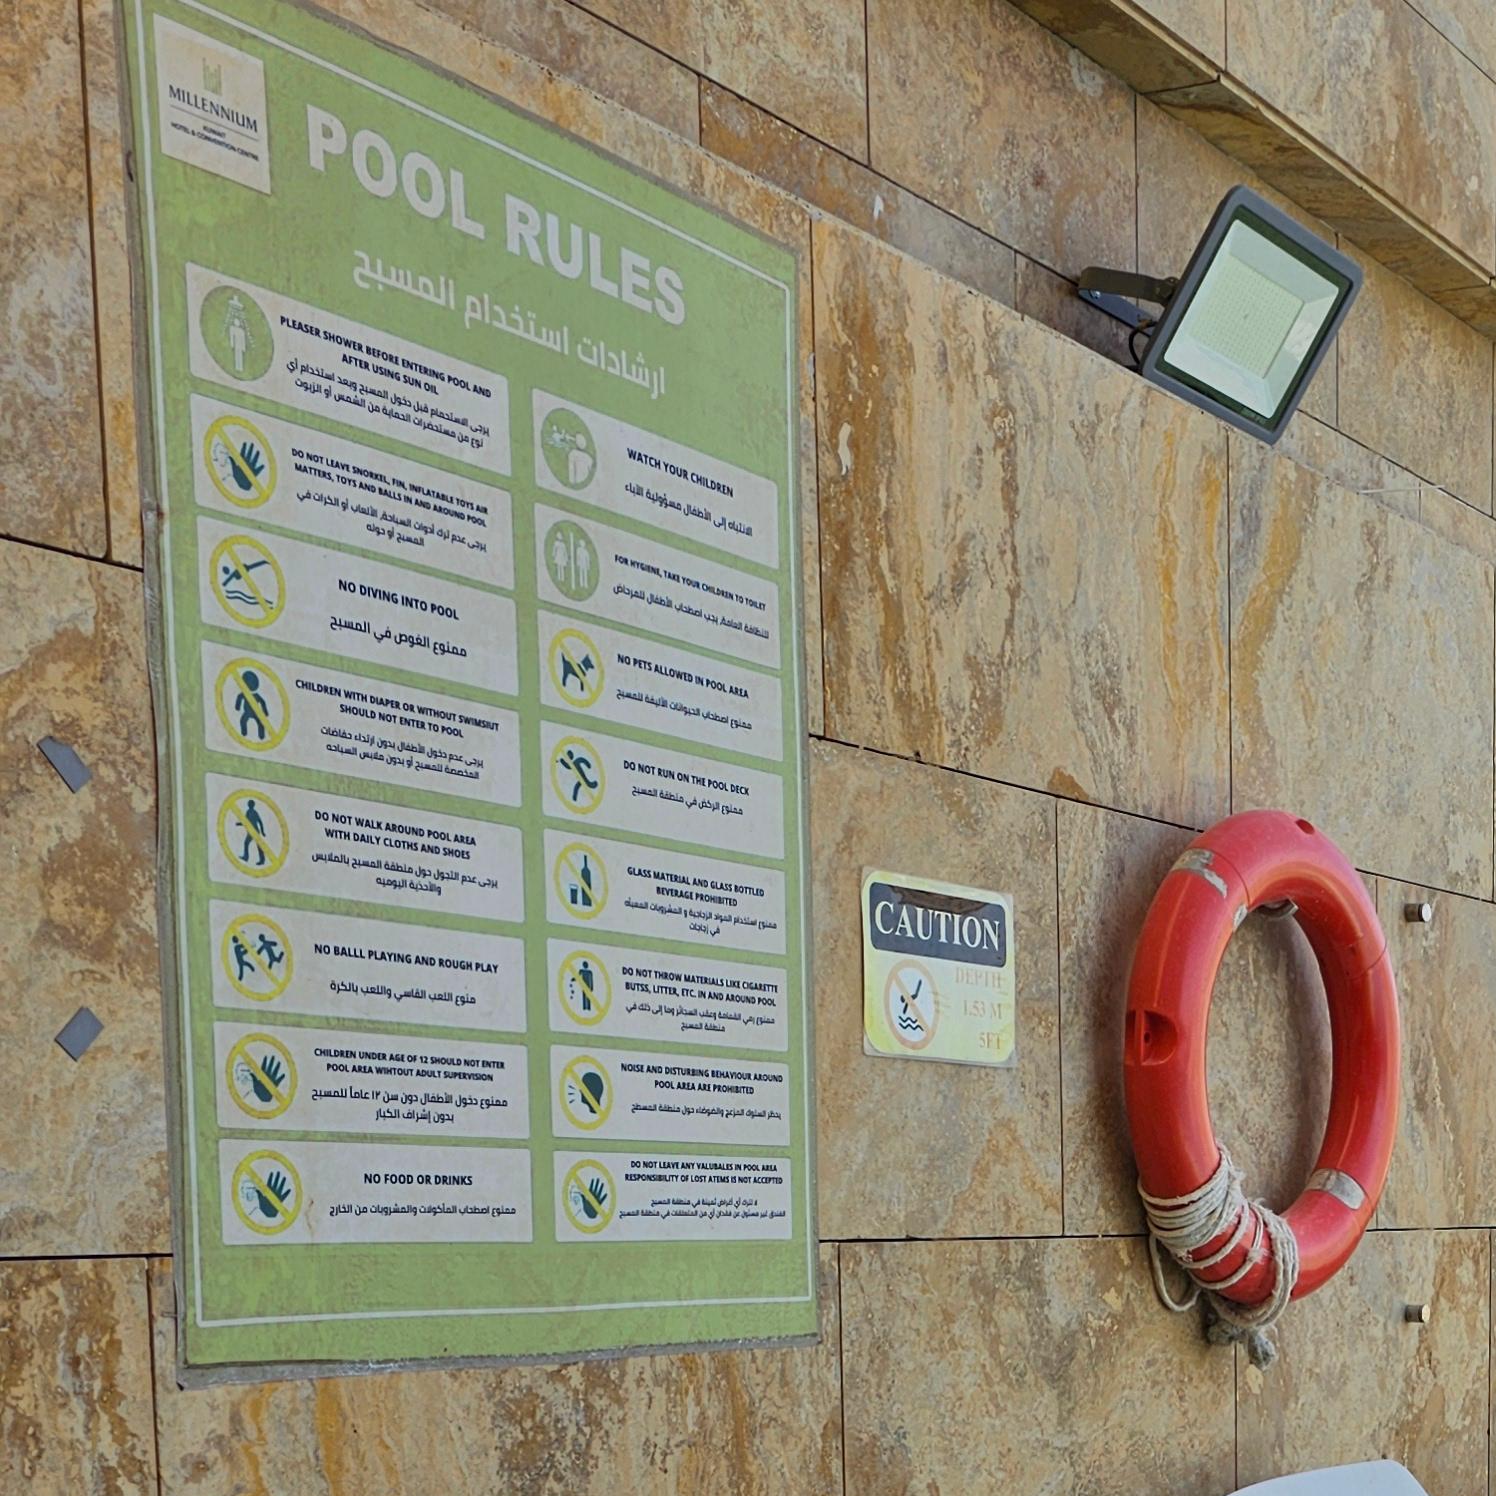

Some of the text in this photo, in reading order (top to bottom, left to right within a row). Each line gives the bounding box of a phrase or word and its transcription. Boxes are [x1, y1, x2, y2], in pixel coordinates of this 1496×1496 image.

[169, 84, 258, 133] MILLENNIUM
[306, 105, 687, 328] POOL RULES
[352, 249, 457, 307] المسبح
[463, 294, 571, 354] استخدام
[280, 315, 491, 398] PLEASER SHOWER BEFORE ENTERING POOL AND
[341, 353, 439, 395] AFTER USING SUN OIL
[291, 448, 488, 515] DO NOT LEAVE SNORKEL, FIN, INFLATABLE TOYS AIR
[627, 447, 733, 498] WATCH YOUR CHILDREN
[294, 462, 487, 528] MATTERS, TOYS AND BALLS IN AND AROUND POOL
[338, 579, 459, 620] NO DIVING INTO POOL
[330, 616, 467, 657] ممنوع الغوص في المسبح
[617, 653, 749, 699] NO PETS ALLOWED IN POOL AREA
[295, 679, 341, 697] CHILDREN
[343, 689, 368, 703] WITH
[369, 695, 401, 710] DIAPER
[402, 702, 415, 713] OR
[416, 705, 457, 722] WITHOUT
[340, 704, 464, 738] SHOULD NOT ENTER TO POOL
[623, 760, 749, 796] DO NOT RUN ON THE POOL DECK
[315, 810, 476, 846] DO NOT WALK AROUND POOL AREA
[324, 827, 470, 860] WITH DAILY CLOTHS AND SHOES
[627, 866, 765, 897] GLASS MATERIAL AND GLASS BOTTLED
[656, 886, 738, 907] BEVERAGE PROHIBITED
[875, 900, 1000, 951] CAUTION
[314, 943, 498, 974] NO BALLL PLAYING AND ROUGH PLAY
[329, 980, 359, 995] بالكرة
[360, 985, 392, 999] واللعب
[622, 966, 778, 993] DO NOT THROW MATERIALS LIKE CIGARETTE
[625, 981, 776, 1007] BUTSS, LITTER, ETC. IN AND AROUND POOL
[428, 992, 453, 1002] اللعب
[314, 1048, 505, 1069] CHILDREN UNDER AGE OF 12 SHOULD NOT ENTER
[326, 1063, 493, 1082] POOL AREA WIHTOUT ADULT SUPERVISION
[621, 1063, 783, 1083] NOISE AND DISTURBING BEHAVIOUR AROUND
[311, 1088, 347, 1101] للمسبح
[382, 1091, 399, 1104] سن
[400, 1092, 419, 1105] دون
[420, 1092, 453, 1106] الأطفال
[455, 1094, 478, 1108] دخول
[479, 1096, 508, 1110] ممنوع
[654, 1080, 754, 1095] POOL AREA ARE PROHIBITED
[375, 1108, 454, 1124] بدون إشراف الكبار
[364, 1173, 473, 1186] NO FOOD OR DRINKS
